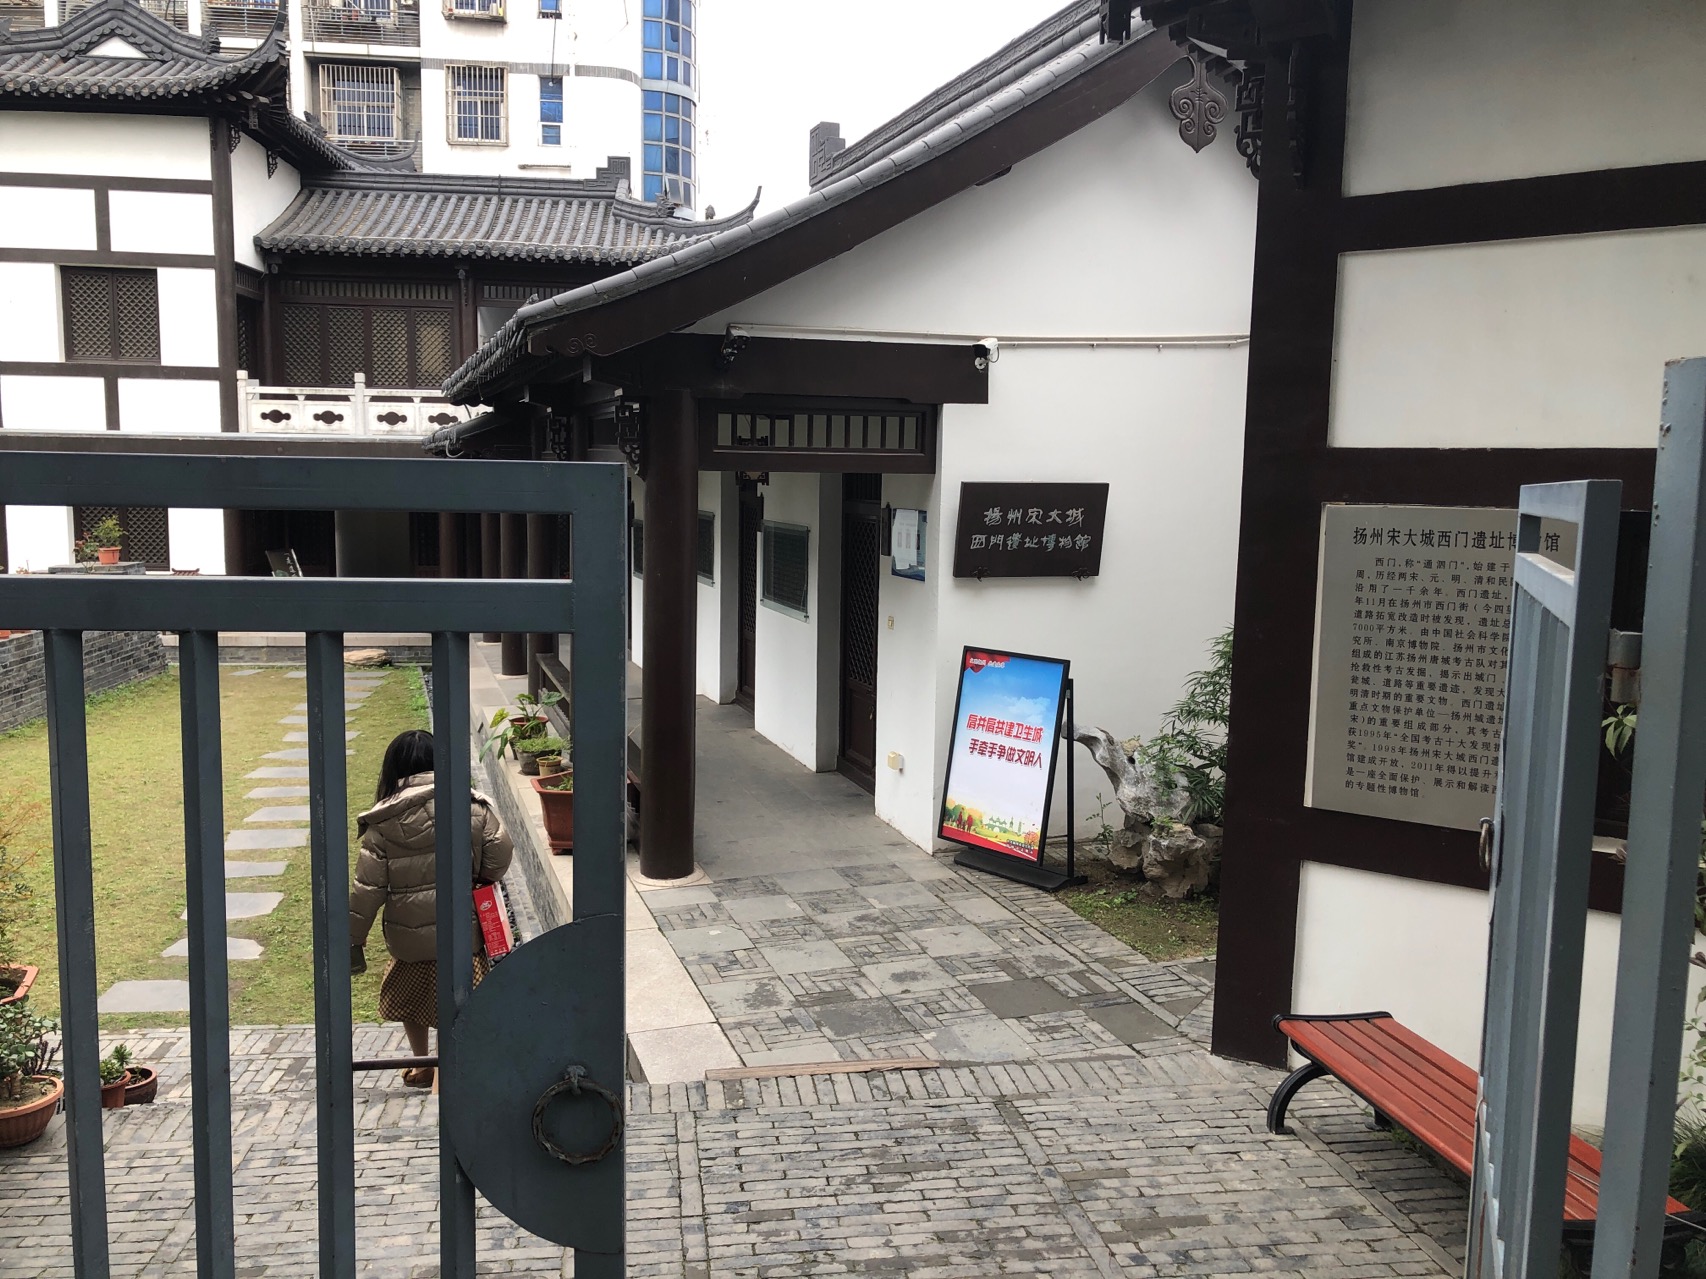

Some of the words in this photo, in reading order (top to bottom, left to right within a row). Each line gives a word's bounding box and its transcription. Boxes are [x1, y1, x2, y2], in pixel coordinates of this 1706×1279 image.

[1353, 527, 1560, 552] 扬州宋大城西门遗址博馆
